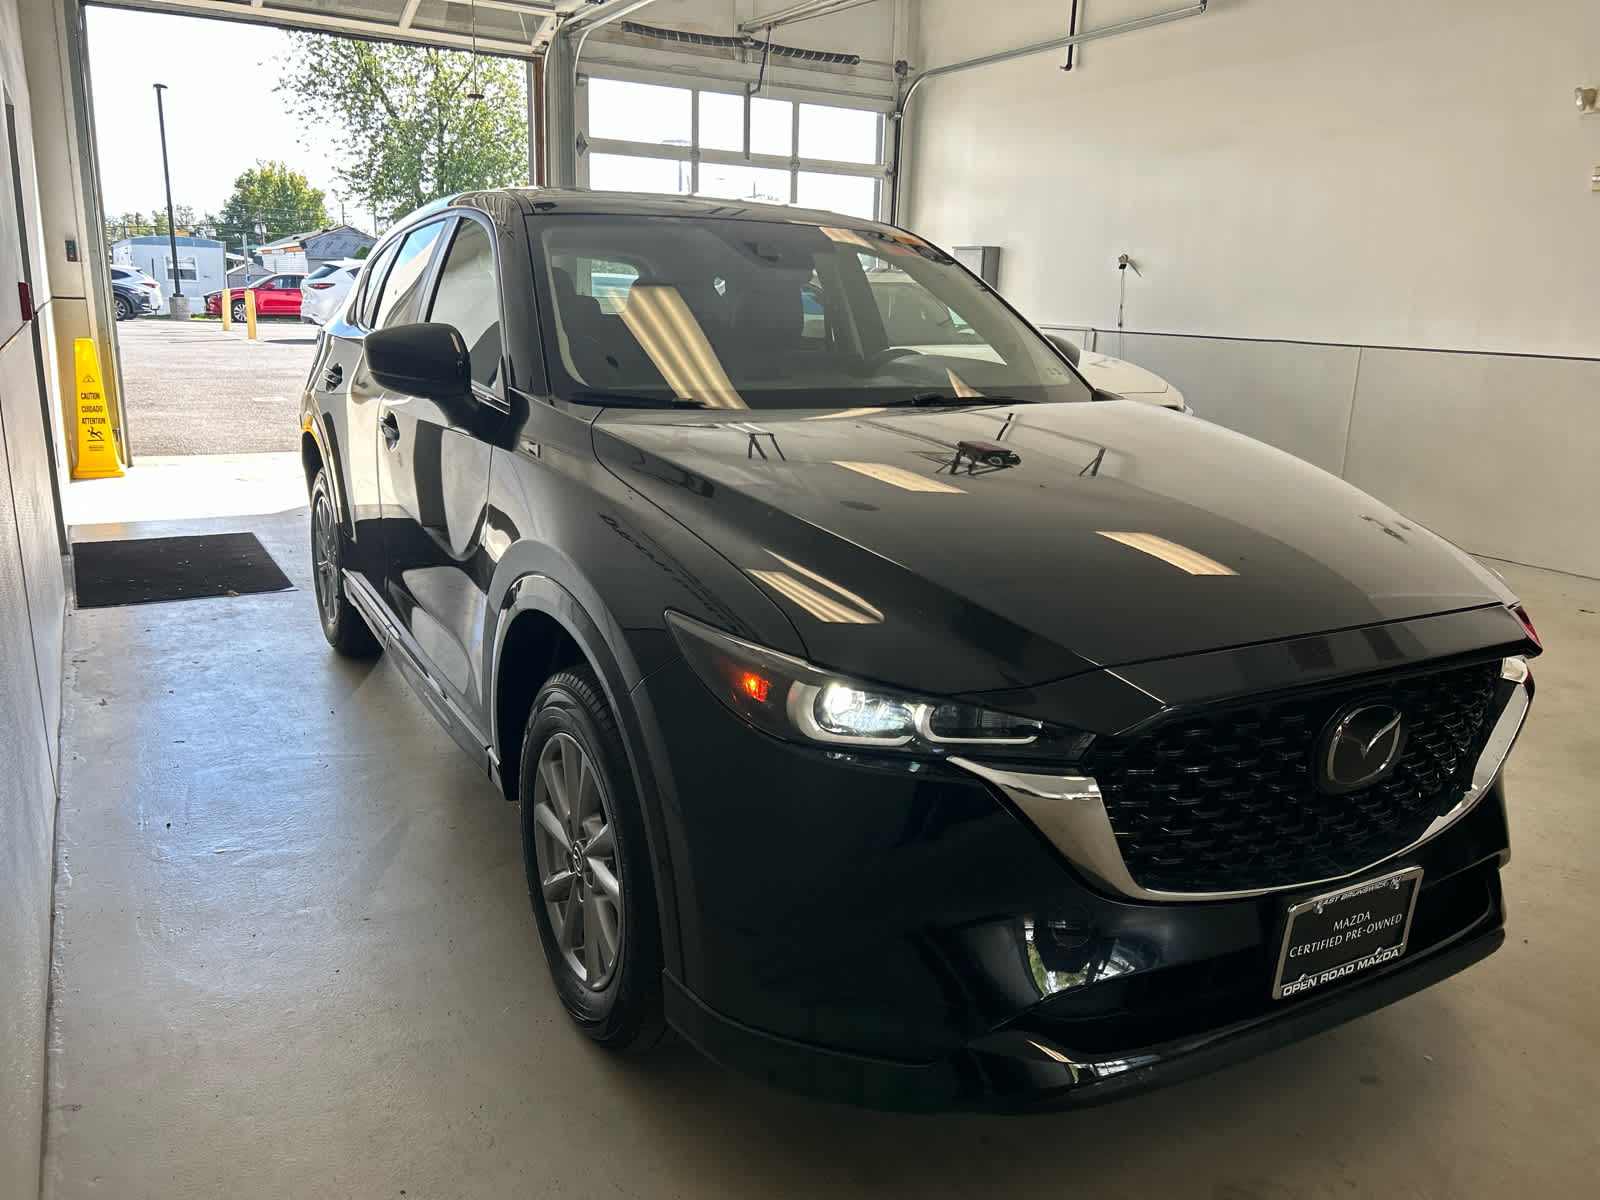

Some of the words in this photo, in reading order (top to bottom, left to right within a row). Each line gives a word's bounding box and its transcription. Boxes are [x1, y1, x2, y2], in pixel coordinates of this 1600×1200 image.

[1289, 935, 1342, 958] CERTIFIED
[1345, 913, 1403, 942] PRE-OWNED
[1333, 911, 1371, 932] MAZDA
[1283, 976, 1318, 996] OPEN
[1320, 963, 1354, 984] ROAD
[1357, 948, 1399, 970] MAZDA
